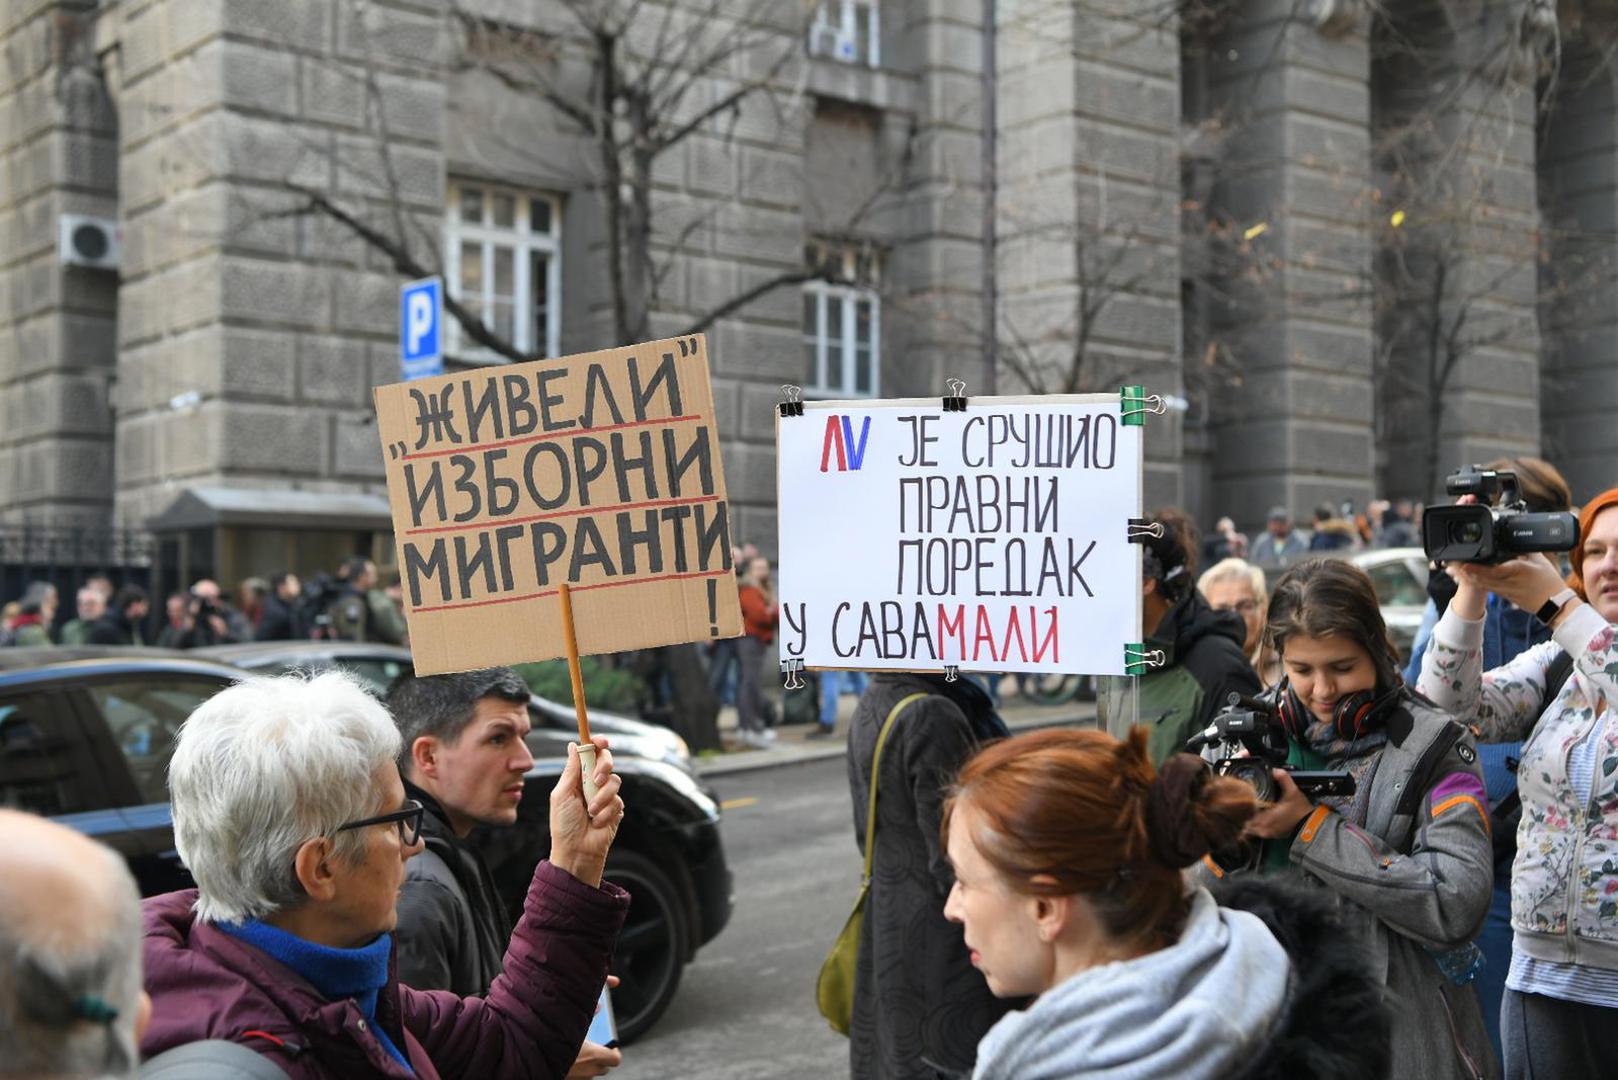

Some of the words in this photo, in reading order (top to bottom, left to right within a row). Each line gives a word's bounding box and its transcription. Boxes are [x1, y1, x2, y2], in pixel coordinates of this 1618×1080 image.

[408, 290, 433, 355] P
[897, 415, 940, 467] ЈЕ
[961, 413, 1117, 470] СРУШИО
[404, 425, 714, 527] ИЗБОРНИ
[899, 475, 1058, 534] ПРАВНИ
[403, 501, 732, 606] МИГРАНТИ
[896, 537, 1097, 598] ПОРЕДАК
[783, 602, 807, 656] У
[832, 601, 1060, 664] САВАМАЛИ
